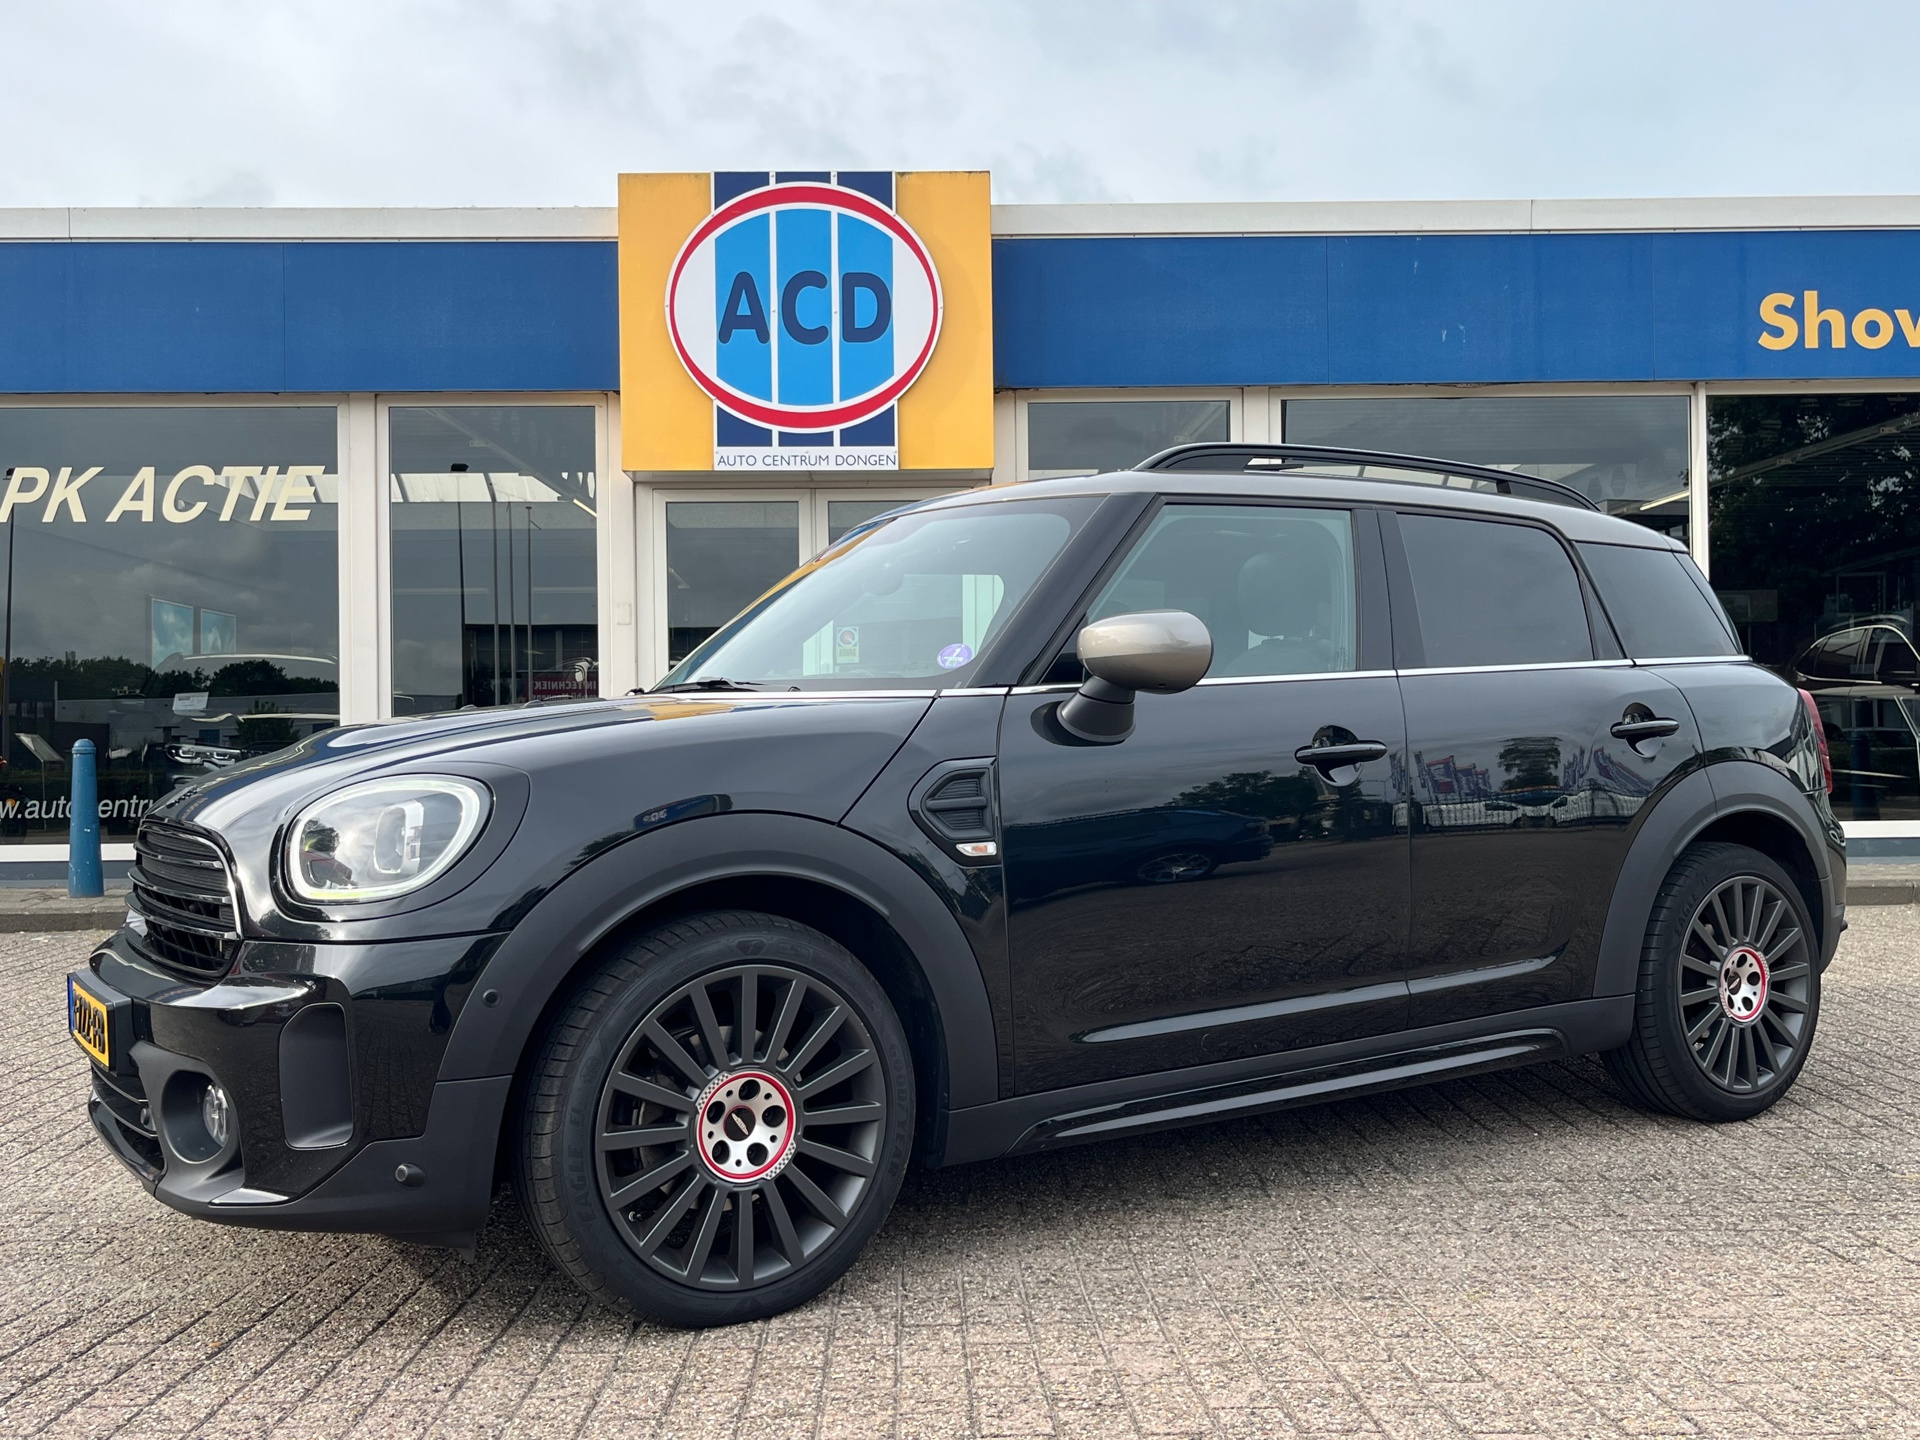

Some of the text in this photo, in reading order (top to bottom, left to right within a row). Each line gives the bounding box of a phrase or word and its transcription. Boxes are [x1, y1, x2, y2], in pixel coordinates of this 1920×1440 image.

[718, 270, 892, 345] ACD
[717, 454, 897, 467] AUTO CENTRUM DONGEN
[0, 465, 325, 523] PK ACTIE
